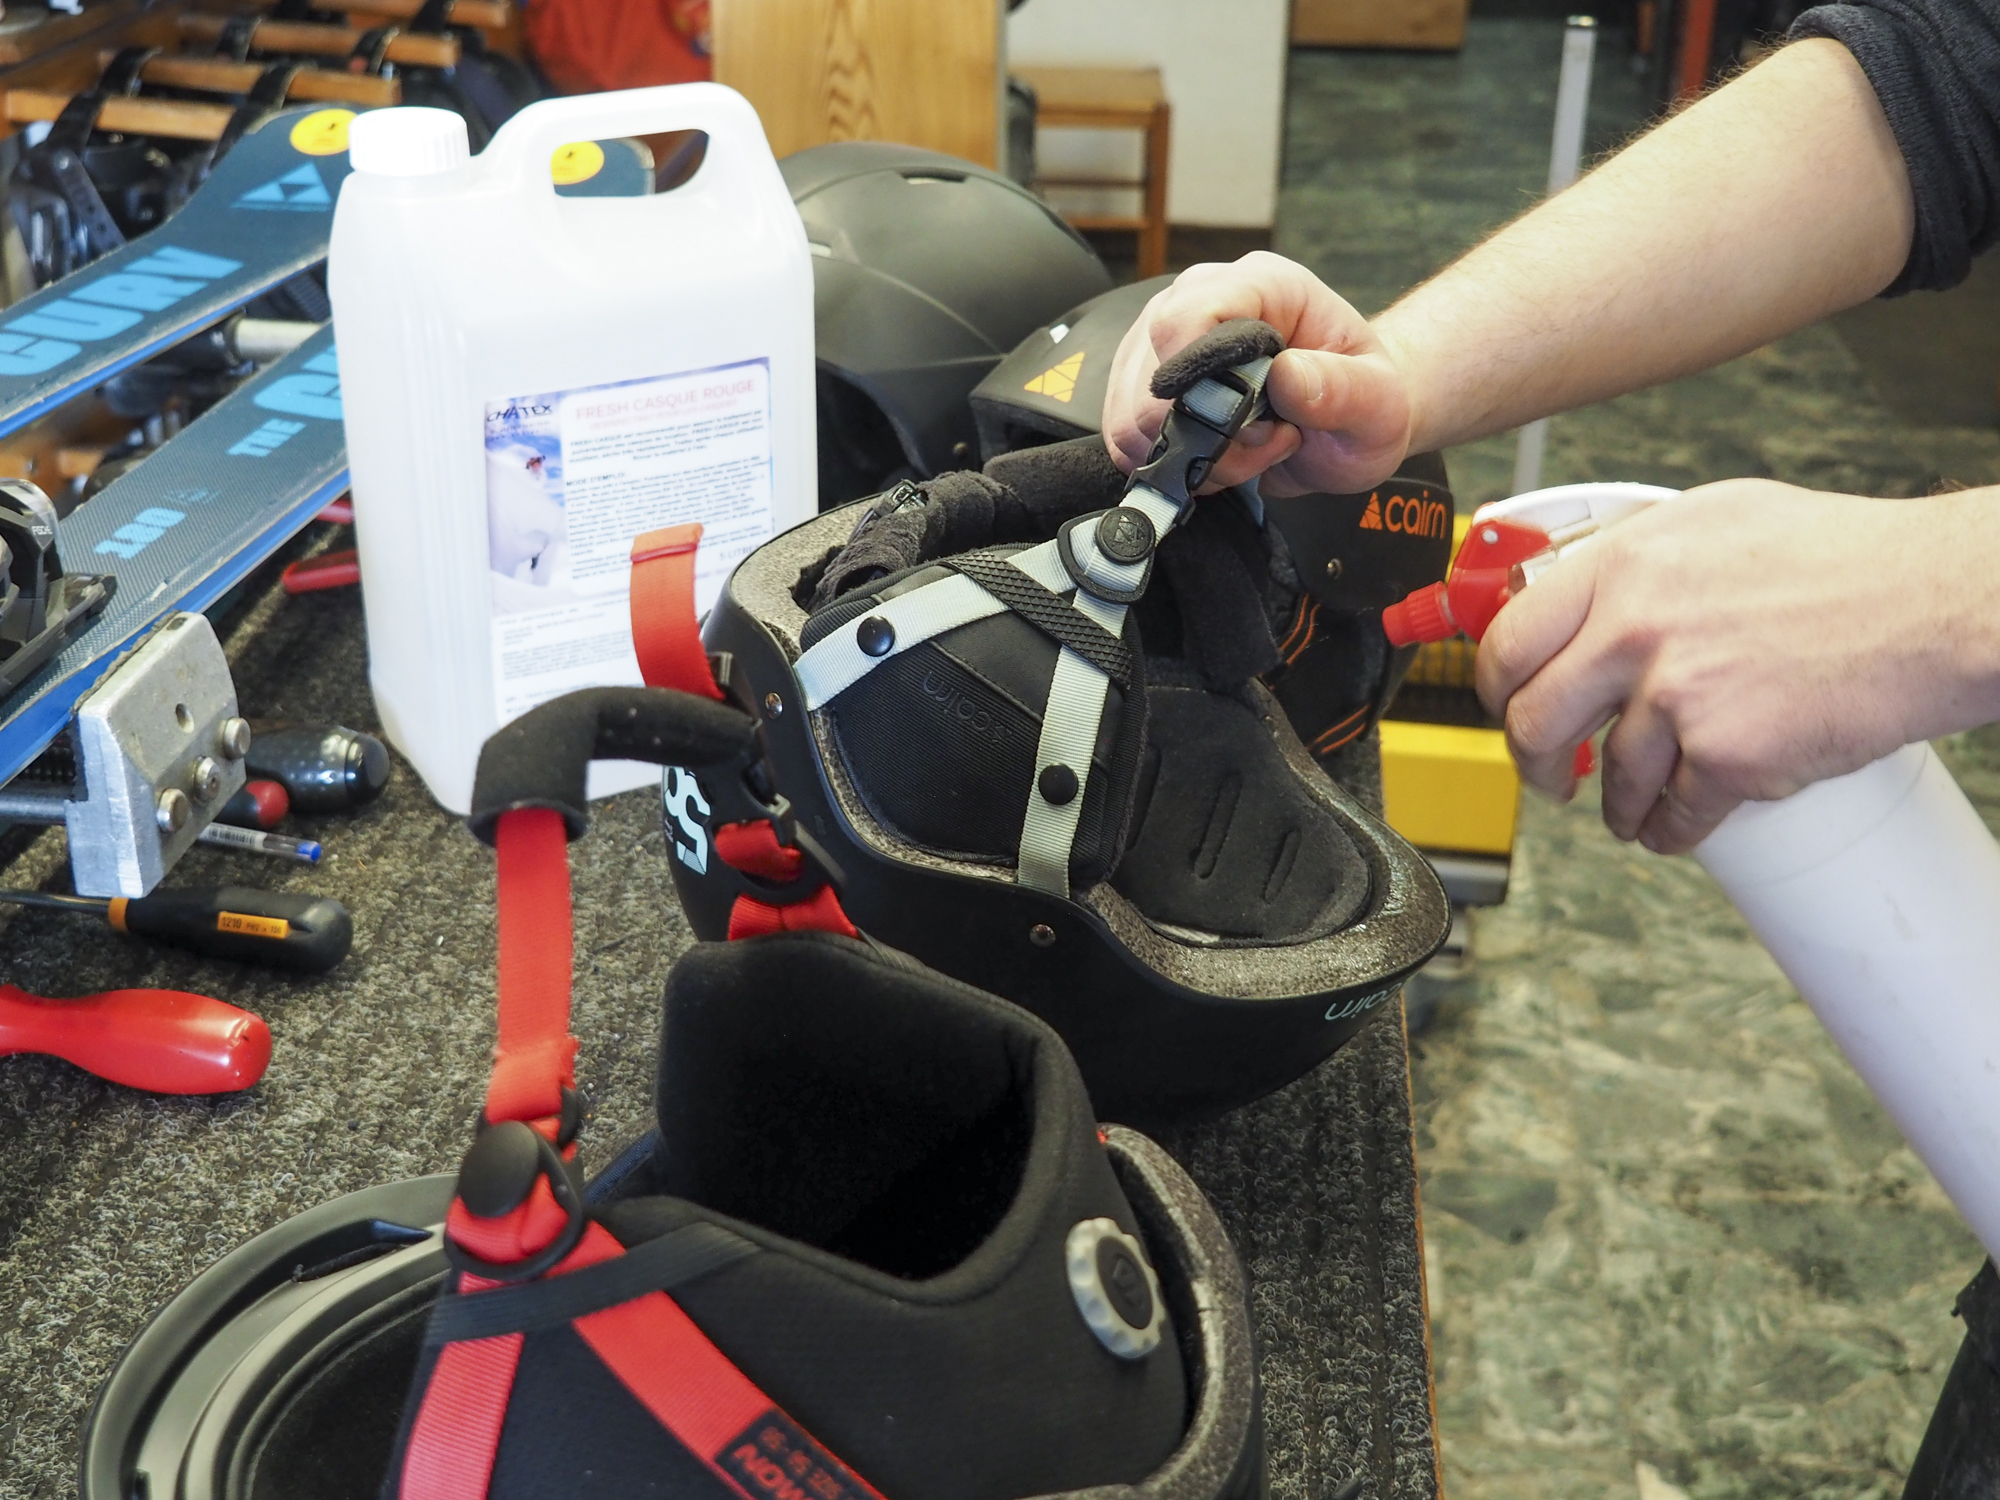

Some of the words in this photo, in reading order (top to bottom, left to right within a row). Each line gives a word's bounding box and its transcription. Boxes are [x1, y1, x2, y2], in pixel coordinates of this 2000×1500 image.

[576, 402, 629, 419] FRESH
[634, 390, 697, 411] CASQUE
[703, 380, 755, 398] ROUGE
[1385, 489, 1446, 539] cairn
